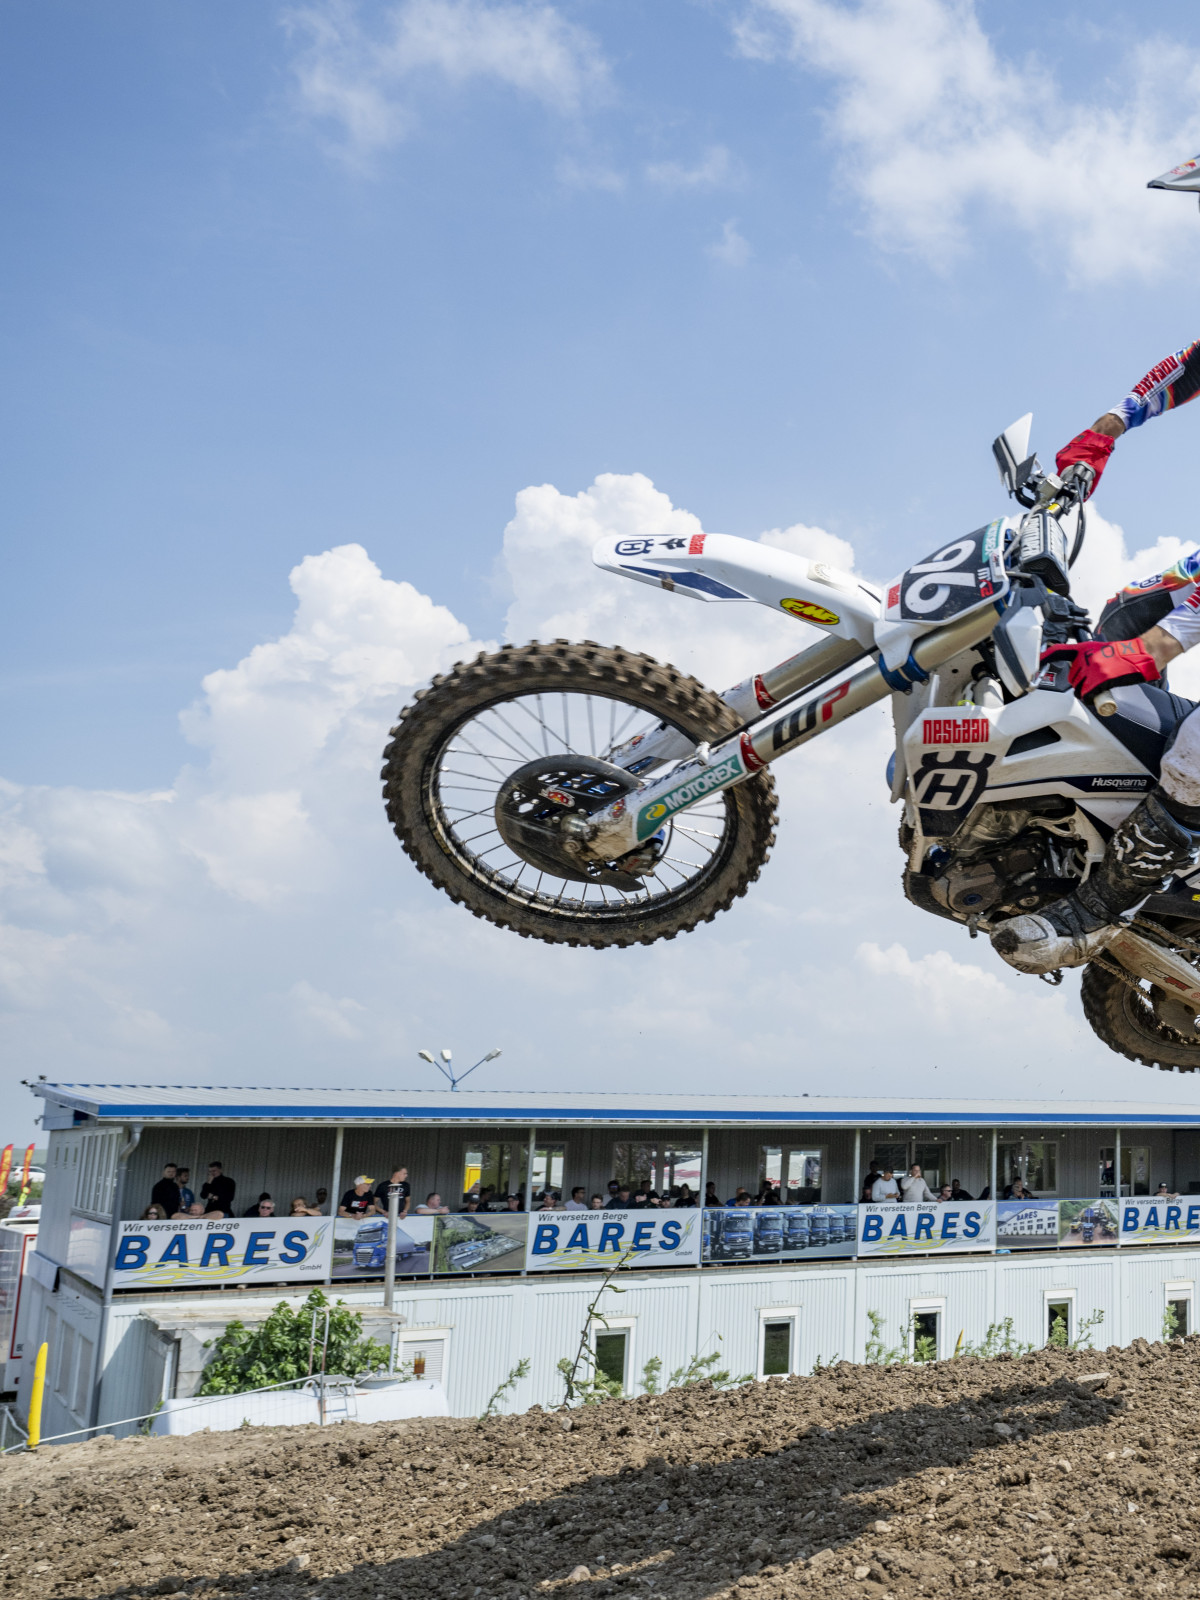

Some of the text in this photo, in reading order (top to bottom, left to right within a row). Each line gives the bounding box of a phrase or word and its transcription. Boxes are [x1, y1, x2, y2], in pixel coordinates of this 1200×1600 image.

[781, 599, 840, 625] FMF
[1084, 641, 1136, 667] FOX
[922, 718, 990, 745] nestaan
[664, 758, 741, 812] MOTOREX
[1091, 777, 1148, 788] Husqvarna
[538, 1211, 629, 1223] Wir versetzen Berge
[866, 1203, 938, 1214] Wir versetzen Berge
[123, 1220, 240, 1233] Wir versetzen Berge
[531, 1220, 683, 1255] BARES
[861, 1211, 982, 1242] BARES
[114, 1229, 310, 1271] BARES
[299, 1263, 323, 1272] GmbH
